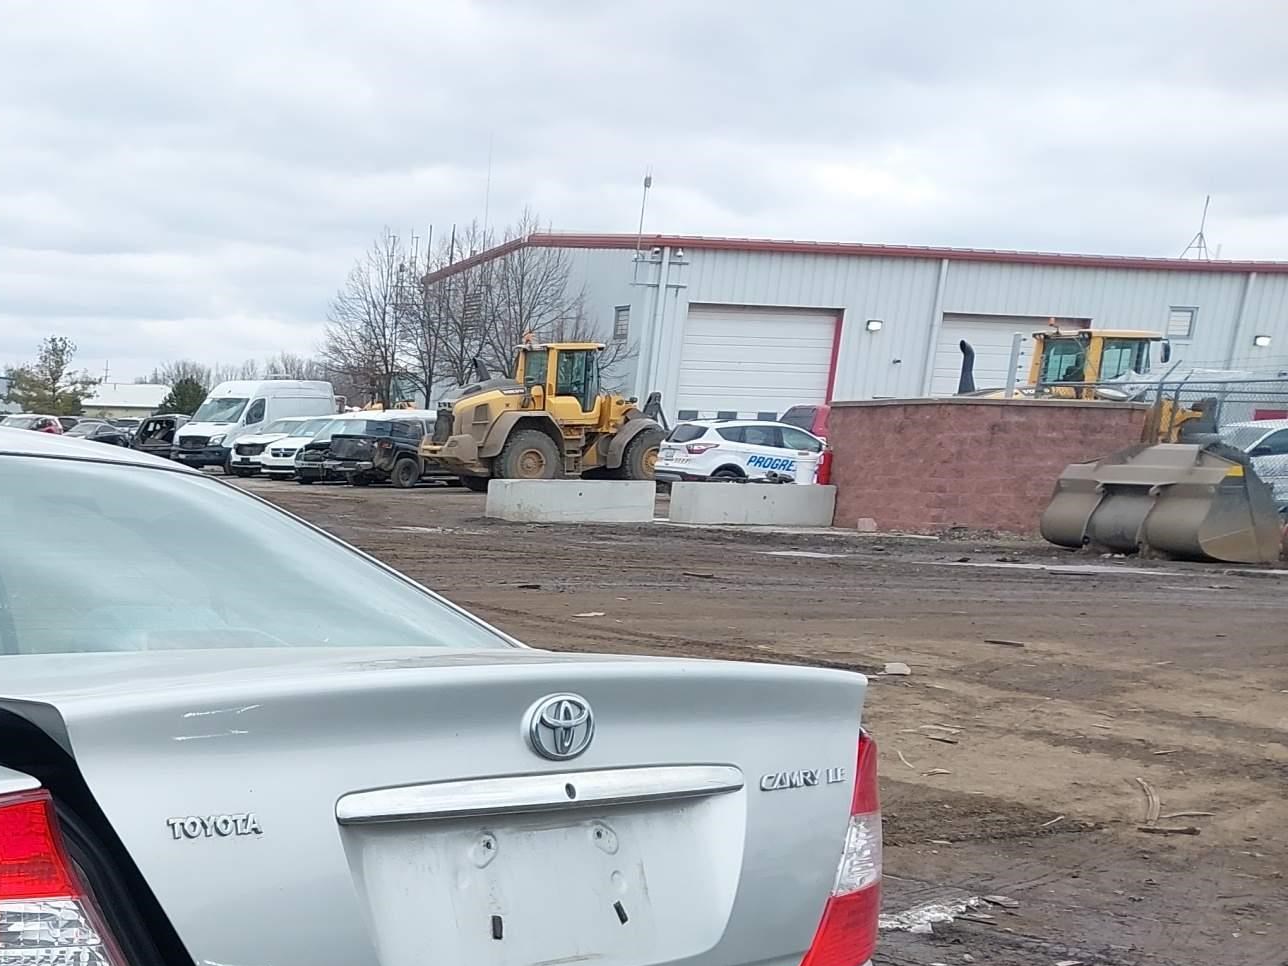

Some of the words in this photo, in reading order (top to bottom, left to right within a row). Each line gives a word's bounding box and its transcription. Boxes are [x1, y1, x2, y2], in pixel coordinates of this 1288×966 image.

[746, 455, 797, 472] PROGRE
[760, 769, 821, 791] CAMRY
[826, 767, 847, 784] LE
[166, 812, 263, 840] TOYOTA
